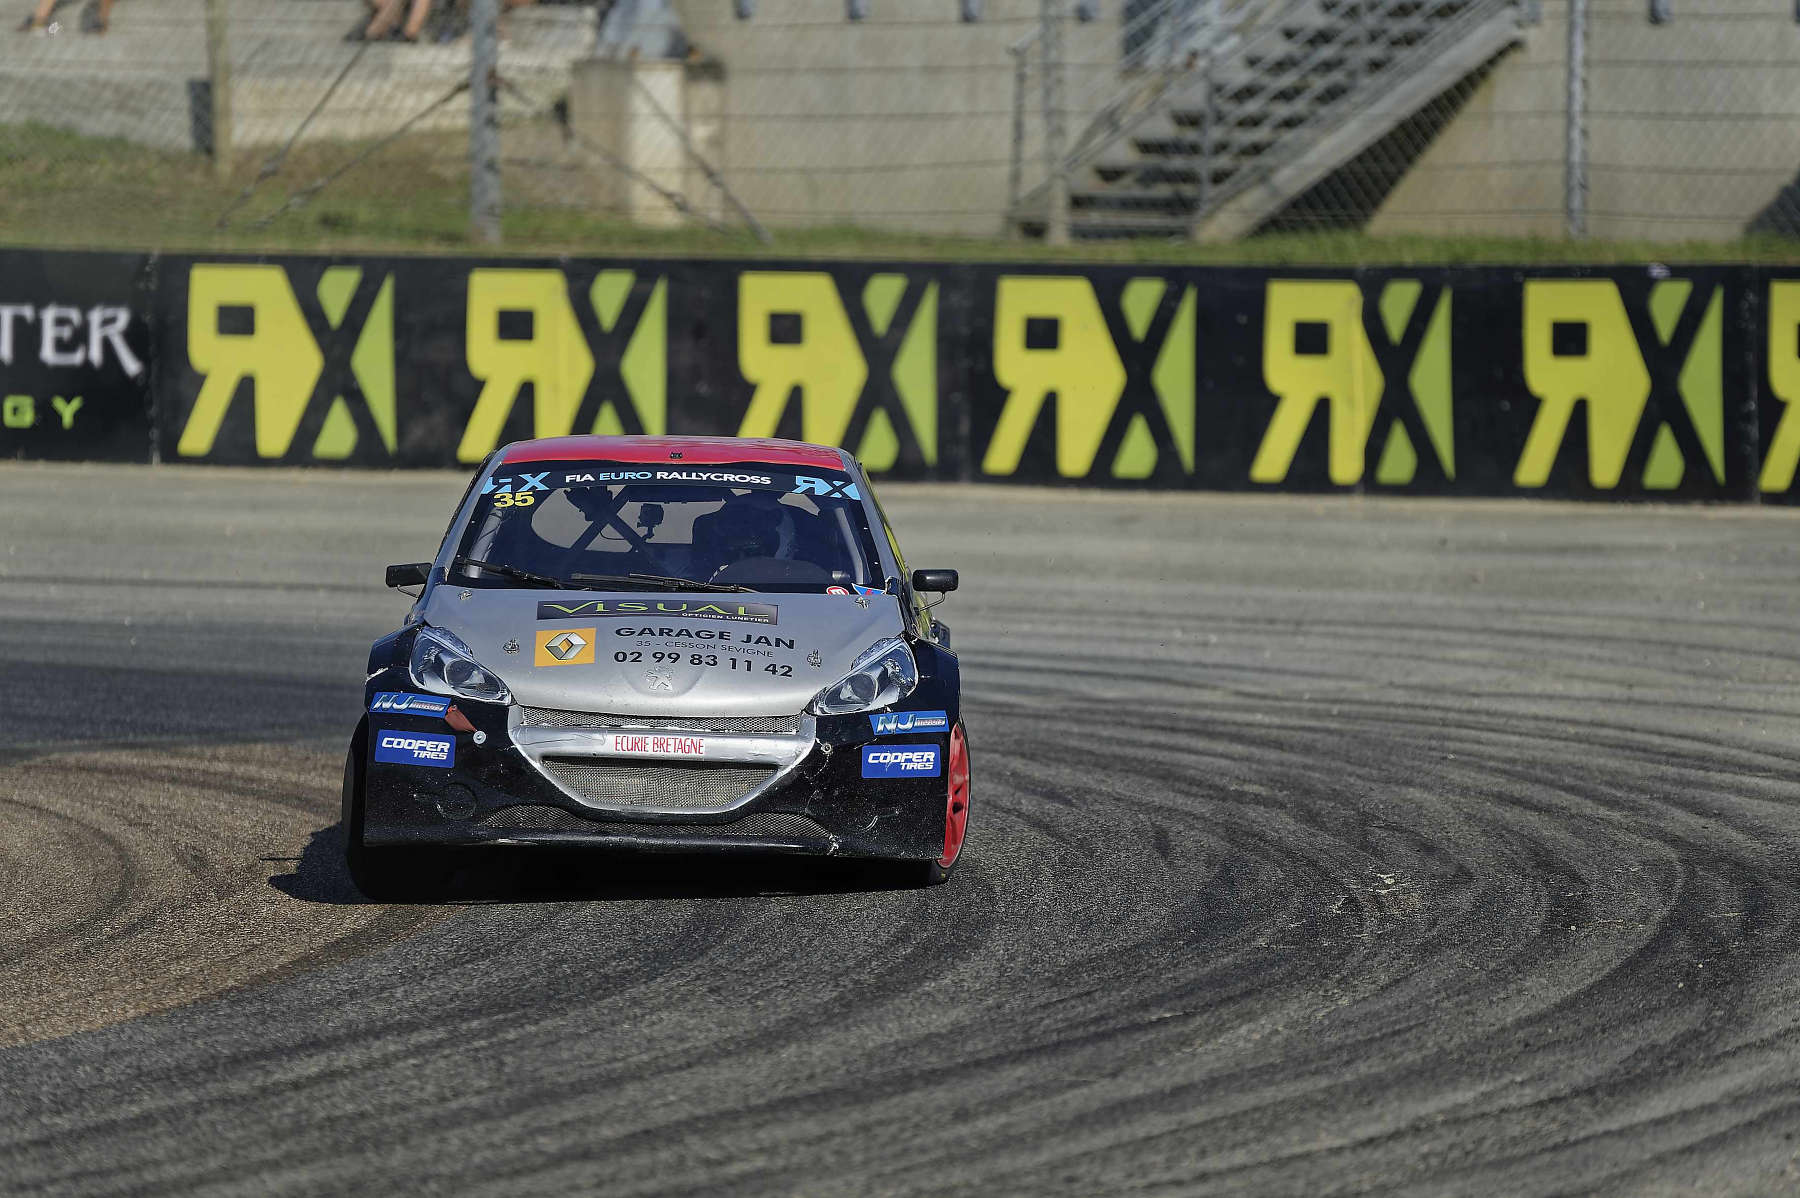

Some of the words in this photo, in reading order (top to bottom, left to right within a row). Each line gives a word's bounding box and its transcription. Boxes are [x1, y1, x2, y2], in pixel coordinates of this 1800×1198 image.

[565, 473, 596, 483] FIA
[599, 471, 652, 481] EURO
[656, 471, 772, 485] RALLYCROSS
[493, 491, 535, 508] 35
[544, 600, 768, 617] VISUAL
[615, 627, 731, 641] GARAGE
[740, 634, 795, 650] JAN
[665, 641, 716, 650] CESSON
[721, 644, 774, 658] SEVIGNE
[613, 651, 643, 663] 02
[652, 651, 681, 664] 99
[689, 653, 718, 667] 83
[729, 657, 752, 672] 11
[764, 663, 793, 678] 42
[372, 694, 415, 711] NJ
[876, 713, 916, 732] NJ
[382, 737, 450, 753] COOPER
[615, 735, 649, 752] ECURIE
[652, 736, 704, 754] BRETAGNE
[413, 749, 448, 760] TIRES
[868, 751, 936, 764] COOPER
[901, 761, 935, 771] TIRES
